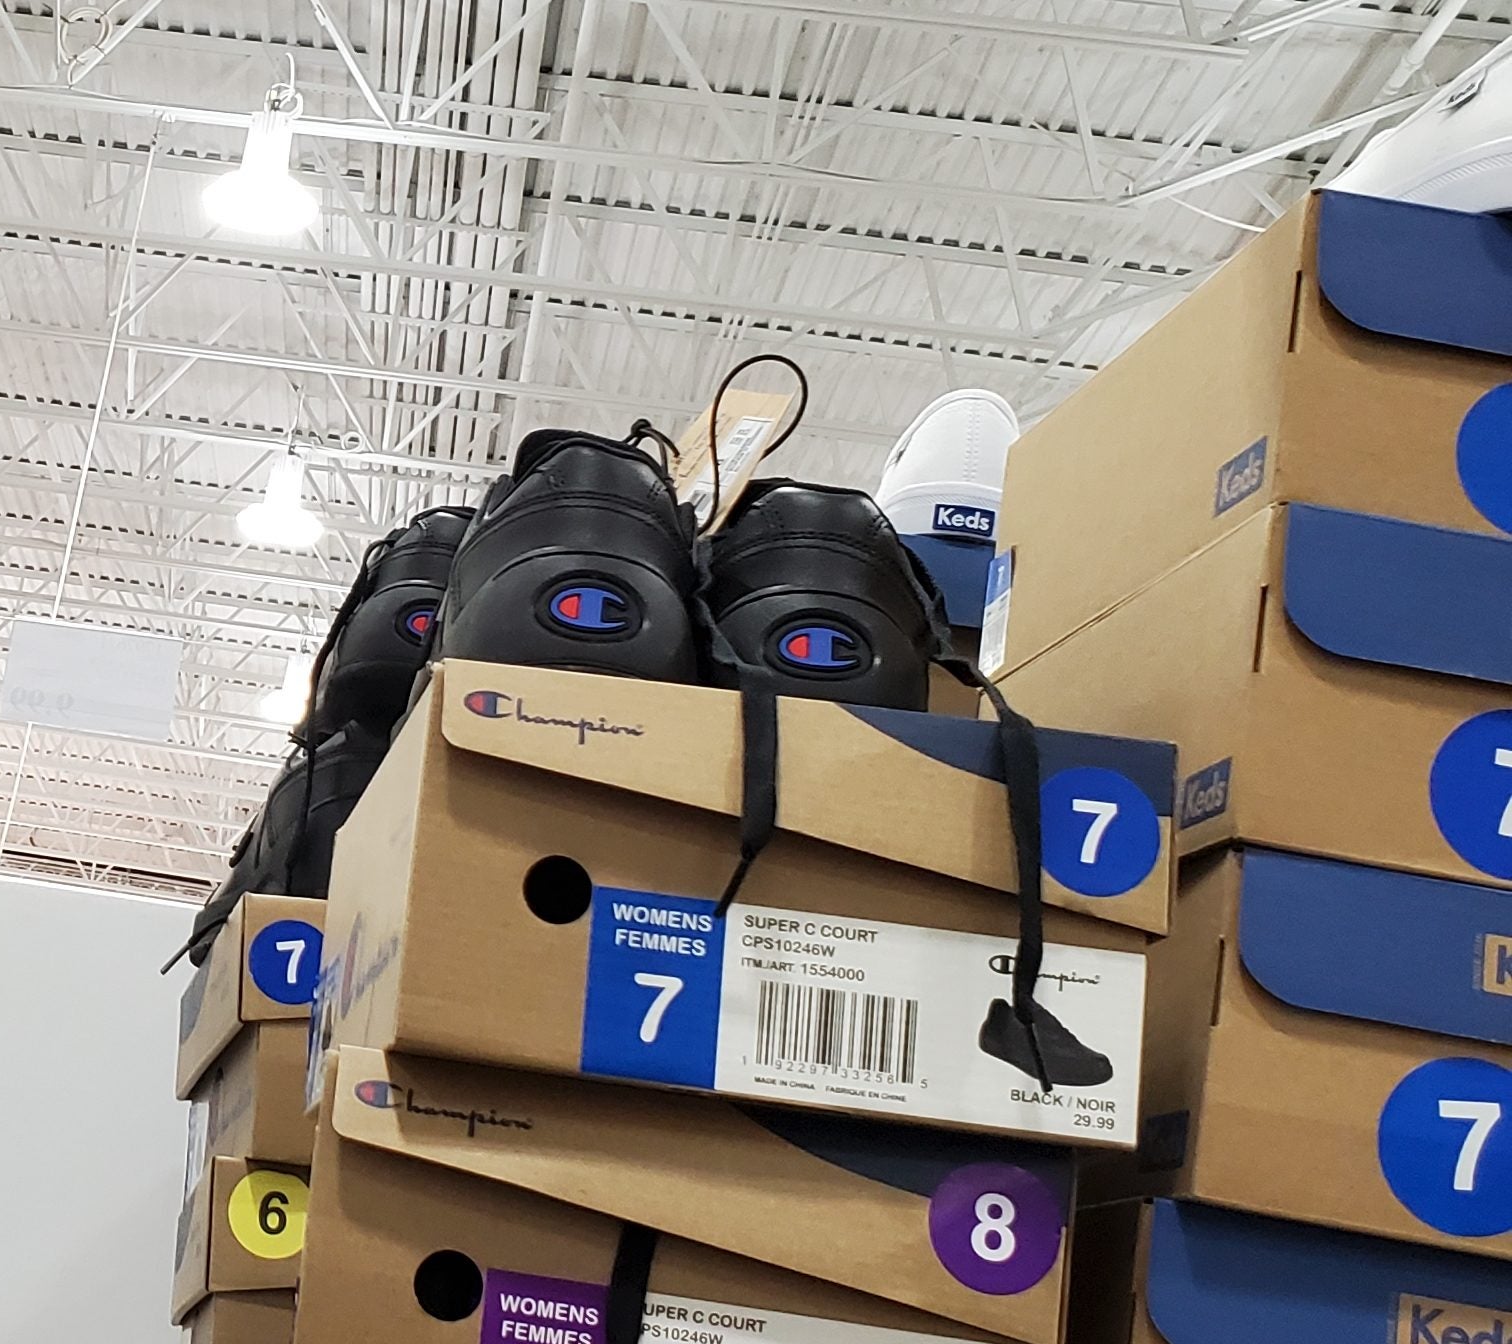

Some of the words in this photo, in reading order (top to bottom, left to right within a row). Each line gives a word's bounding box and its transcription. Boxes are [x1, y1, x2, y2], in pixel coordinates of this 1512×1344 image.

[937, 507, 990, 531] Keds
[463, 690, 644, 745] Champion
[1072, 798, 1117, 864] 7
[612, 902, 713, 933] WOMENS
[744, 914, 800, 934] SUPER
[804, 922, 816, 936] C
[820, 924, 878, 944] COURT
[615, 928, 707, 956] FEMMES
[742, 935, 836, 958] CPS10246W
[275, 939, 305, 984] 7
[800, 963, 865, 982] 1554000
[989, 954, 1101, 992] Cmpion
[634, 972, 684, 1043] 7
[355, 1080, 533, 1137] Champion
[1010, 1087, 1064, 1108] BLACK
[1076, 1097, 1117, 1114] NOIR
[1073, 1113, 1115, 1131] 29.99
[1438, 1099, 1501, 1192] 7
[258, 1191, 290, 1235] 6
[970, 1192, 1015, 1262] 8
[499, 1293, 600, 1326] WOMENS
[641, 1303, 688, 1323] UPER
[692, 1310, 705, 1324] C
[708, 1313, 767, 1333] COURT
